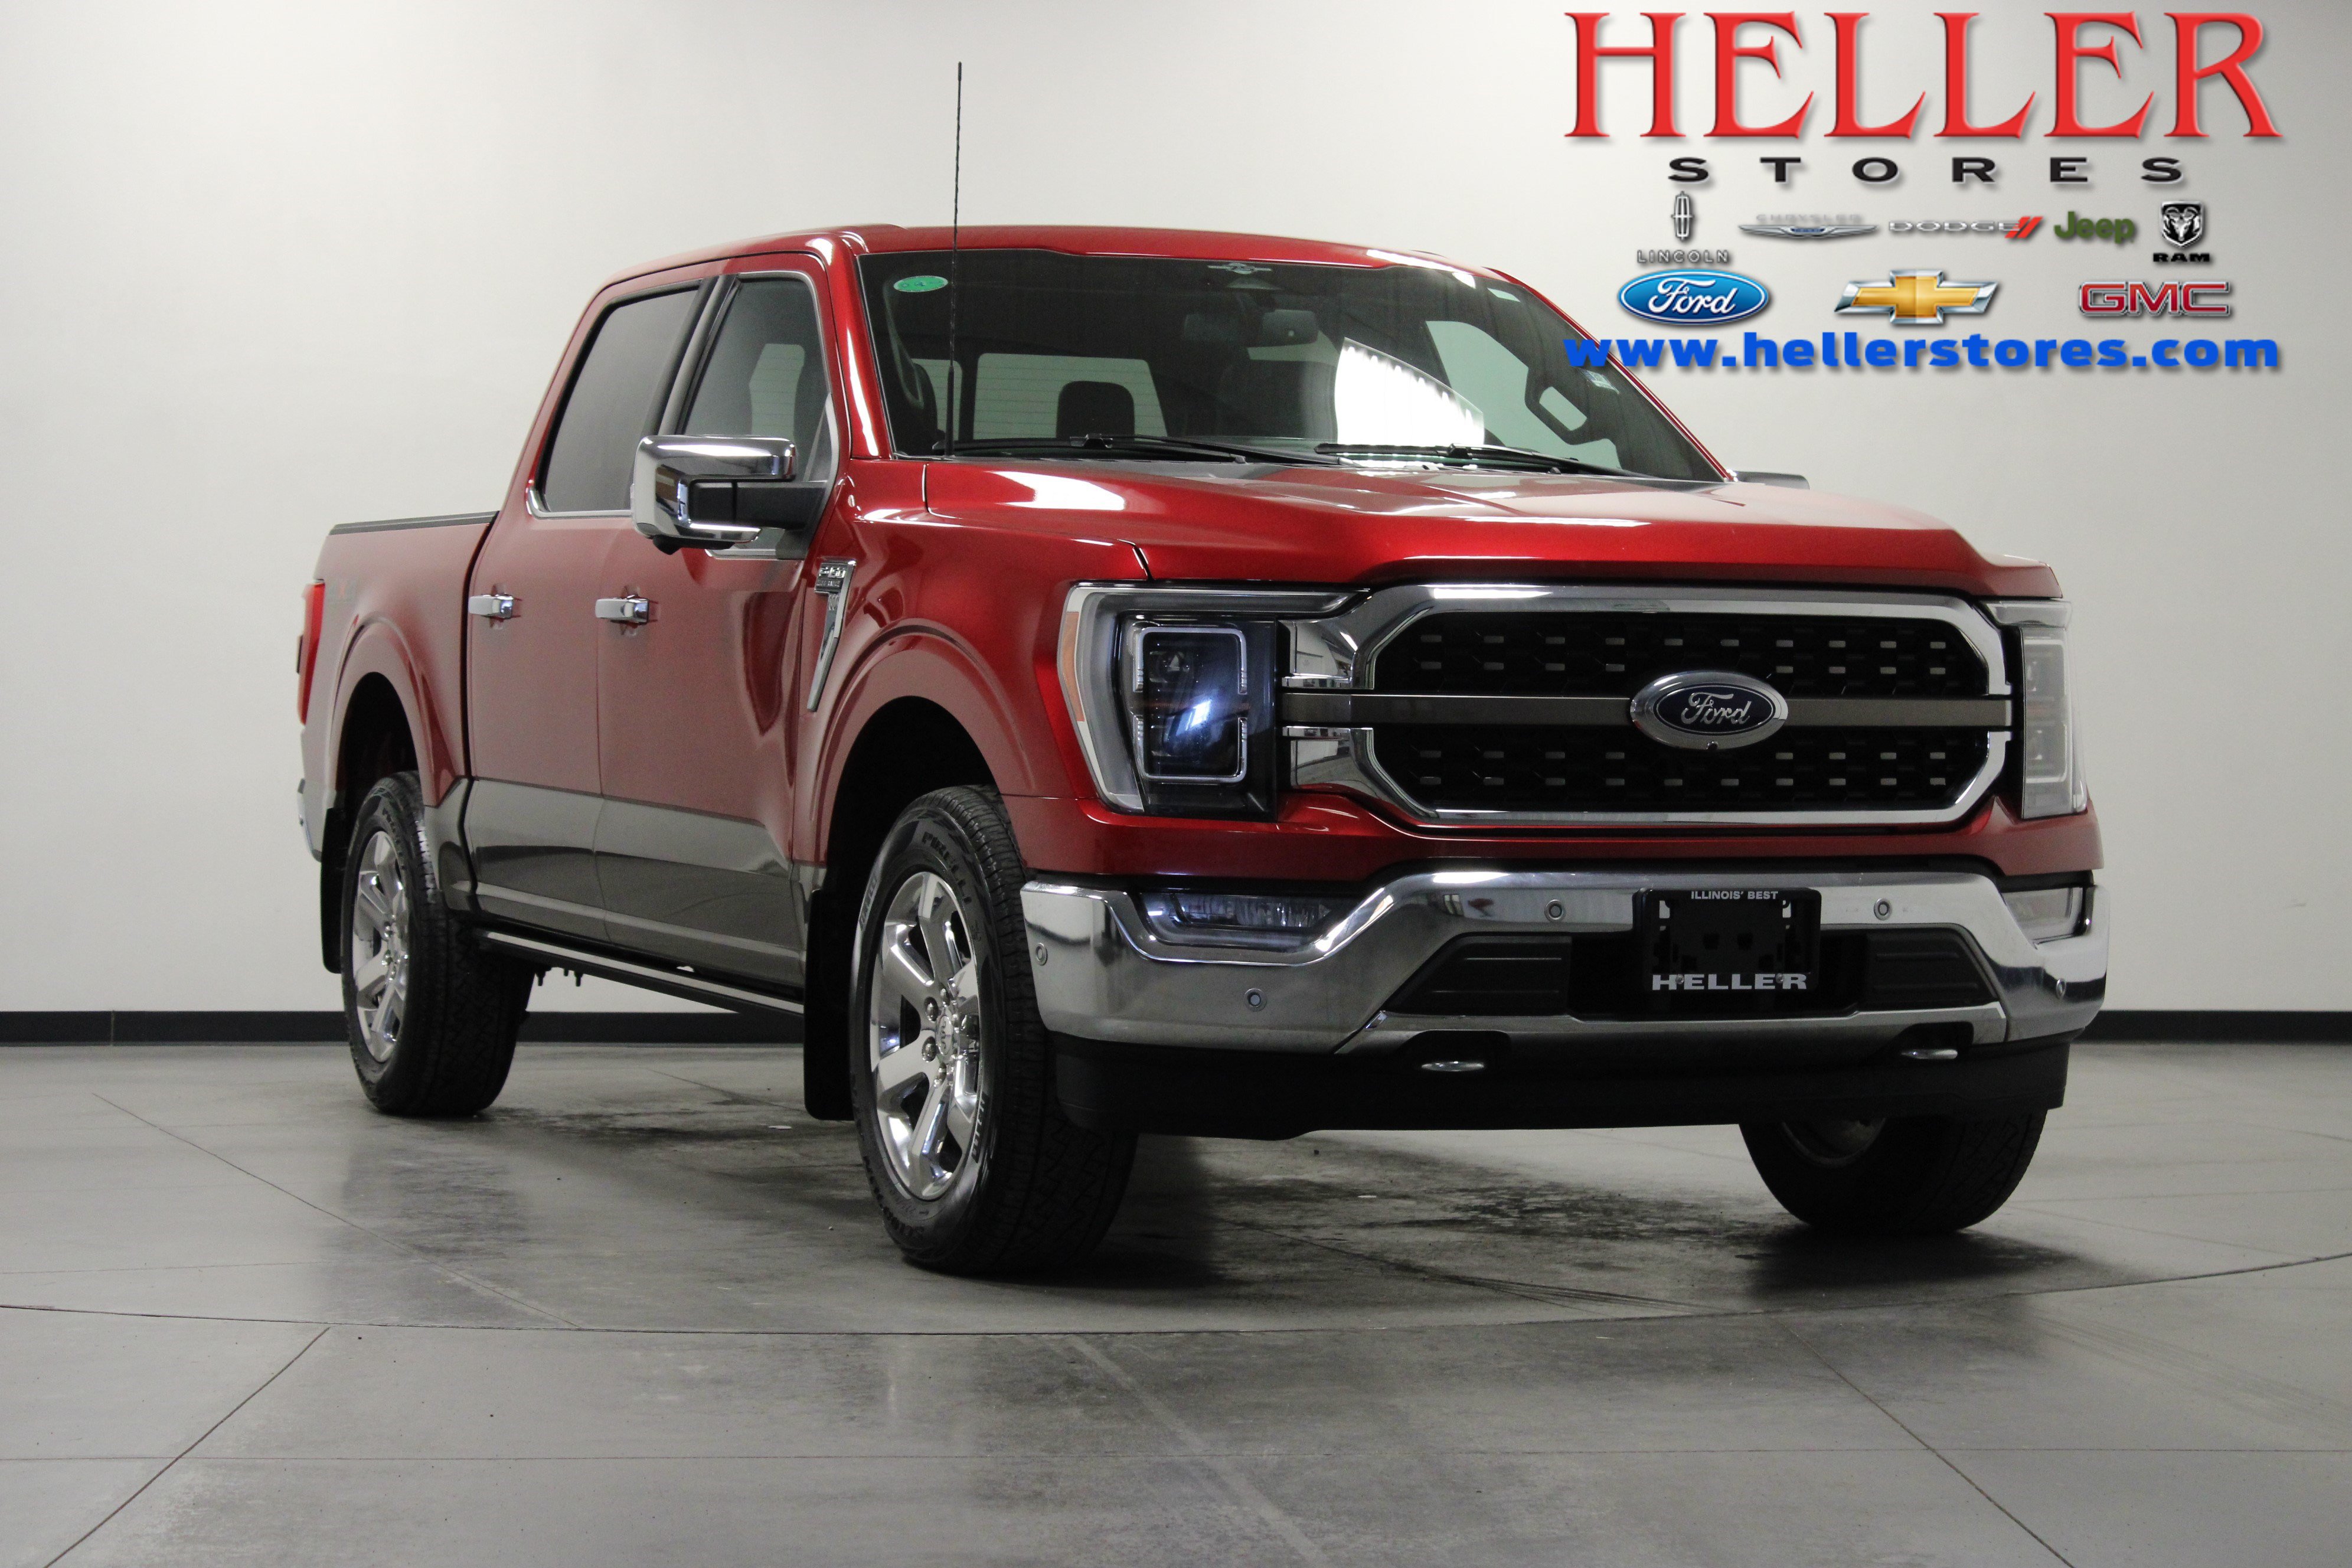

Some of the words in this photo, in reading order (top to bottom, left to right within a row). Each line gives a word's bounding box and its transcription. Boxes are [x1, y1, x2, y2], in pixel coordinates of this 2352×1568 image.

[1681, 691, 1752, 724] Ford
[1747, 891, 1779, 900] BEST
[1652, 973, 1808, 991] HELLER
